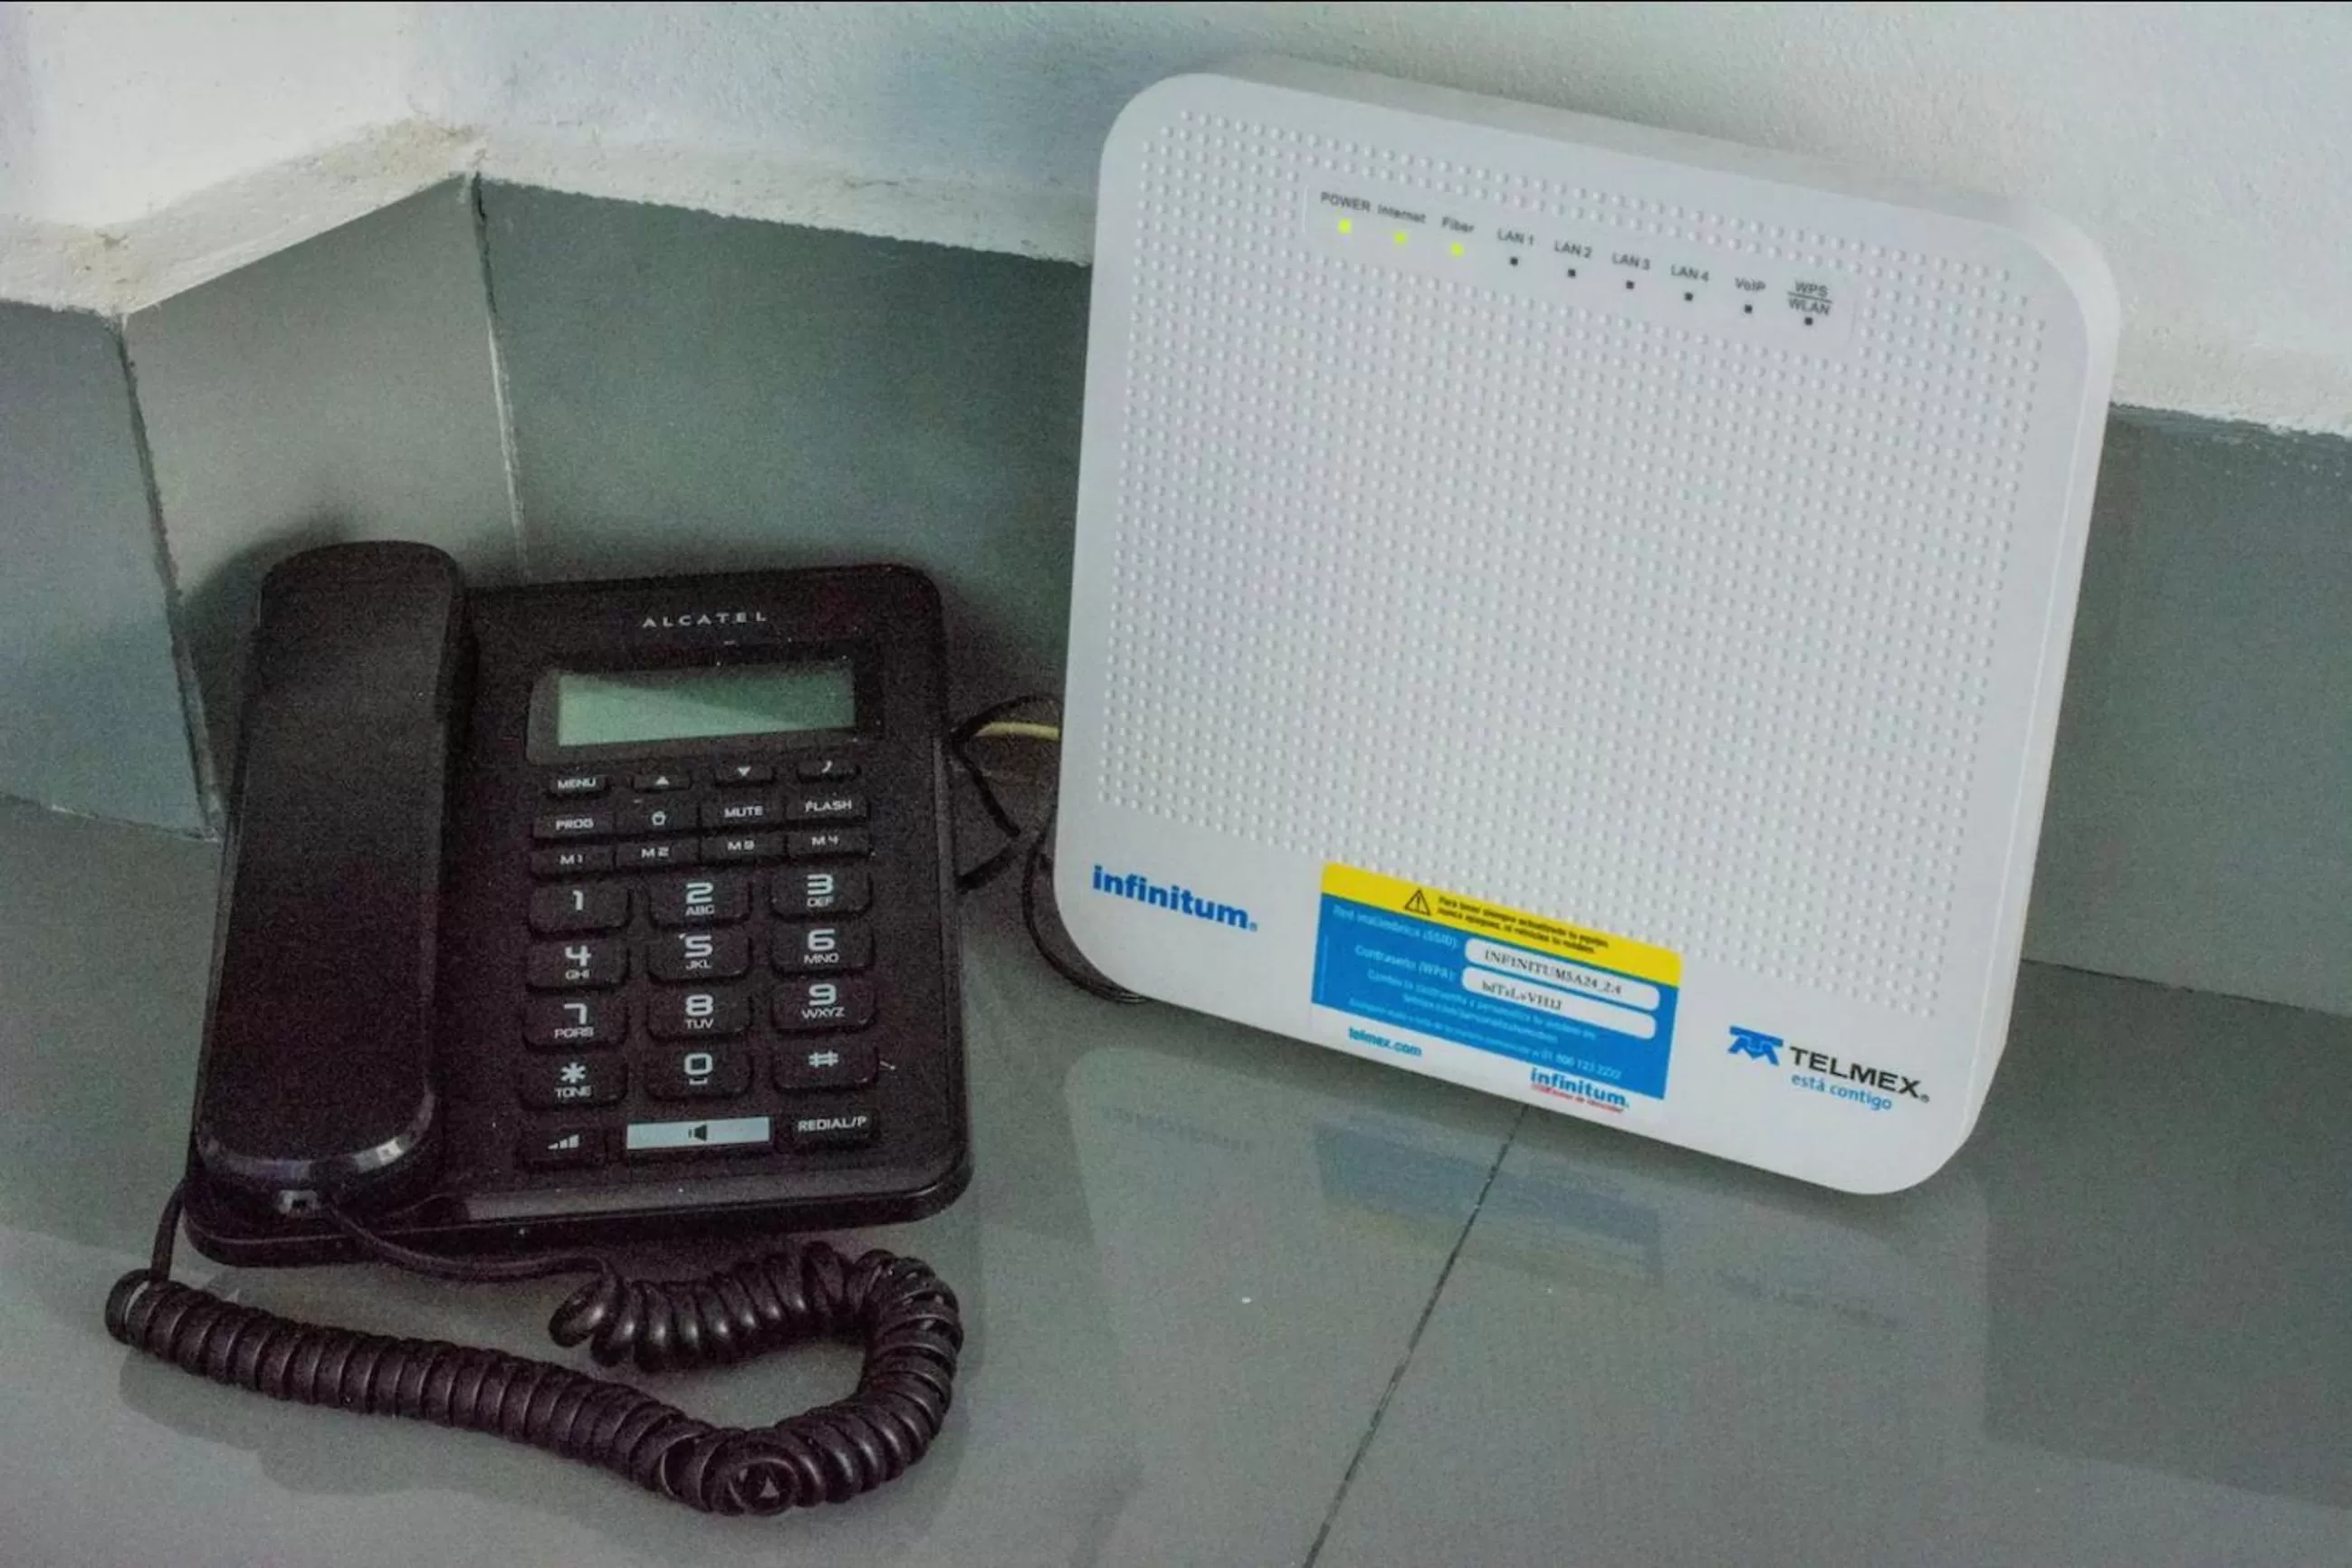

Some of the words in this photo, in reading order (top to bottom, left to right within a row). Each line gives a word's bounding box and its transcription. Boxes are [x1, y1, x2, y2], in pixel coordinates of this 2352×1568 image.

[1320, 191, 1371, 213] POWER
[1378, 204, 1426, 224] Internet
[1441, 216, 1475, 233] Fiber
[1497, 228, 1525, 244] LAN
[1554, 240, 1581, 256] LAN
[1612, 252, 1639, 268] LAN
[1671, 263, 1698, 280] LAN
[1735, 276, 1765, 292] VoIP
[1794, 280, 1829, 298] WPS
[1788, 297, 1830, 316] WLAN
[642, 611, 767, 627] ALCATEL
[558, 778, 597, 789] MENU
[724, 806, 763, 818] MUTE
[805, 799, 852, 813] FLASH
[556, 817, 594, 830] PROG
[686, 882, 713, 904] 2
[807, 874, 834, 895] 3
[572, 890, 584, 912] 1
[807, 895, 834, 907] DEF
[685, 905, 715, 916] ABC
[684, 935, 713, 959] 5
[808, 929, 836, 951] 6
[565, 945, 591, 967] 4
[685, 959, 712, 970] JKL
[804, 953, 839, 964] MNO
[565, 970, 590, 980] GHI
[808, 983, 837, 1006] 9
[564, 1003, 588, 1025] 7
[686, 994, 713, 1017] 8
[802, 1008, 845, 1019] WXYZ
[686, 1018, 713, 1029] TUV
[684, 1053, 713, 1076] 0
[808, 1051, 838, 1068] #
[555, 1086, 591, 1099] TONE
[1791, 1072, 1827, 1093] está
[1830, 1082, 1893, 1112] contigo
[798, 1116, 866, 1133] REDIAL/P
